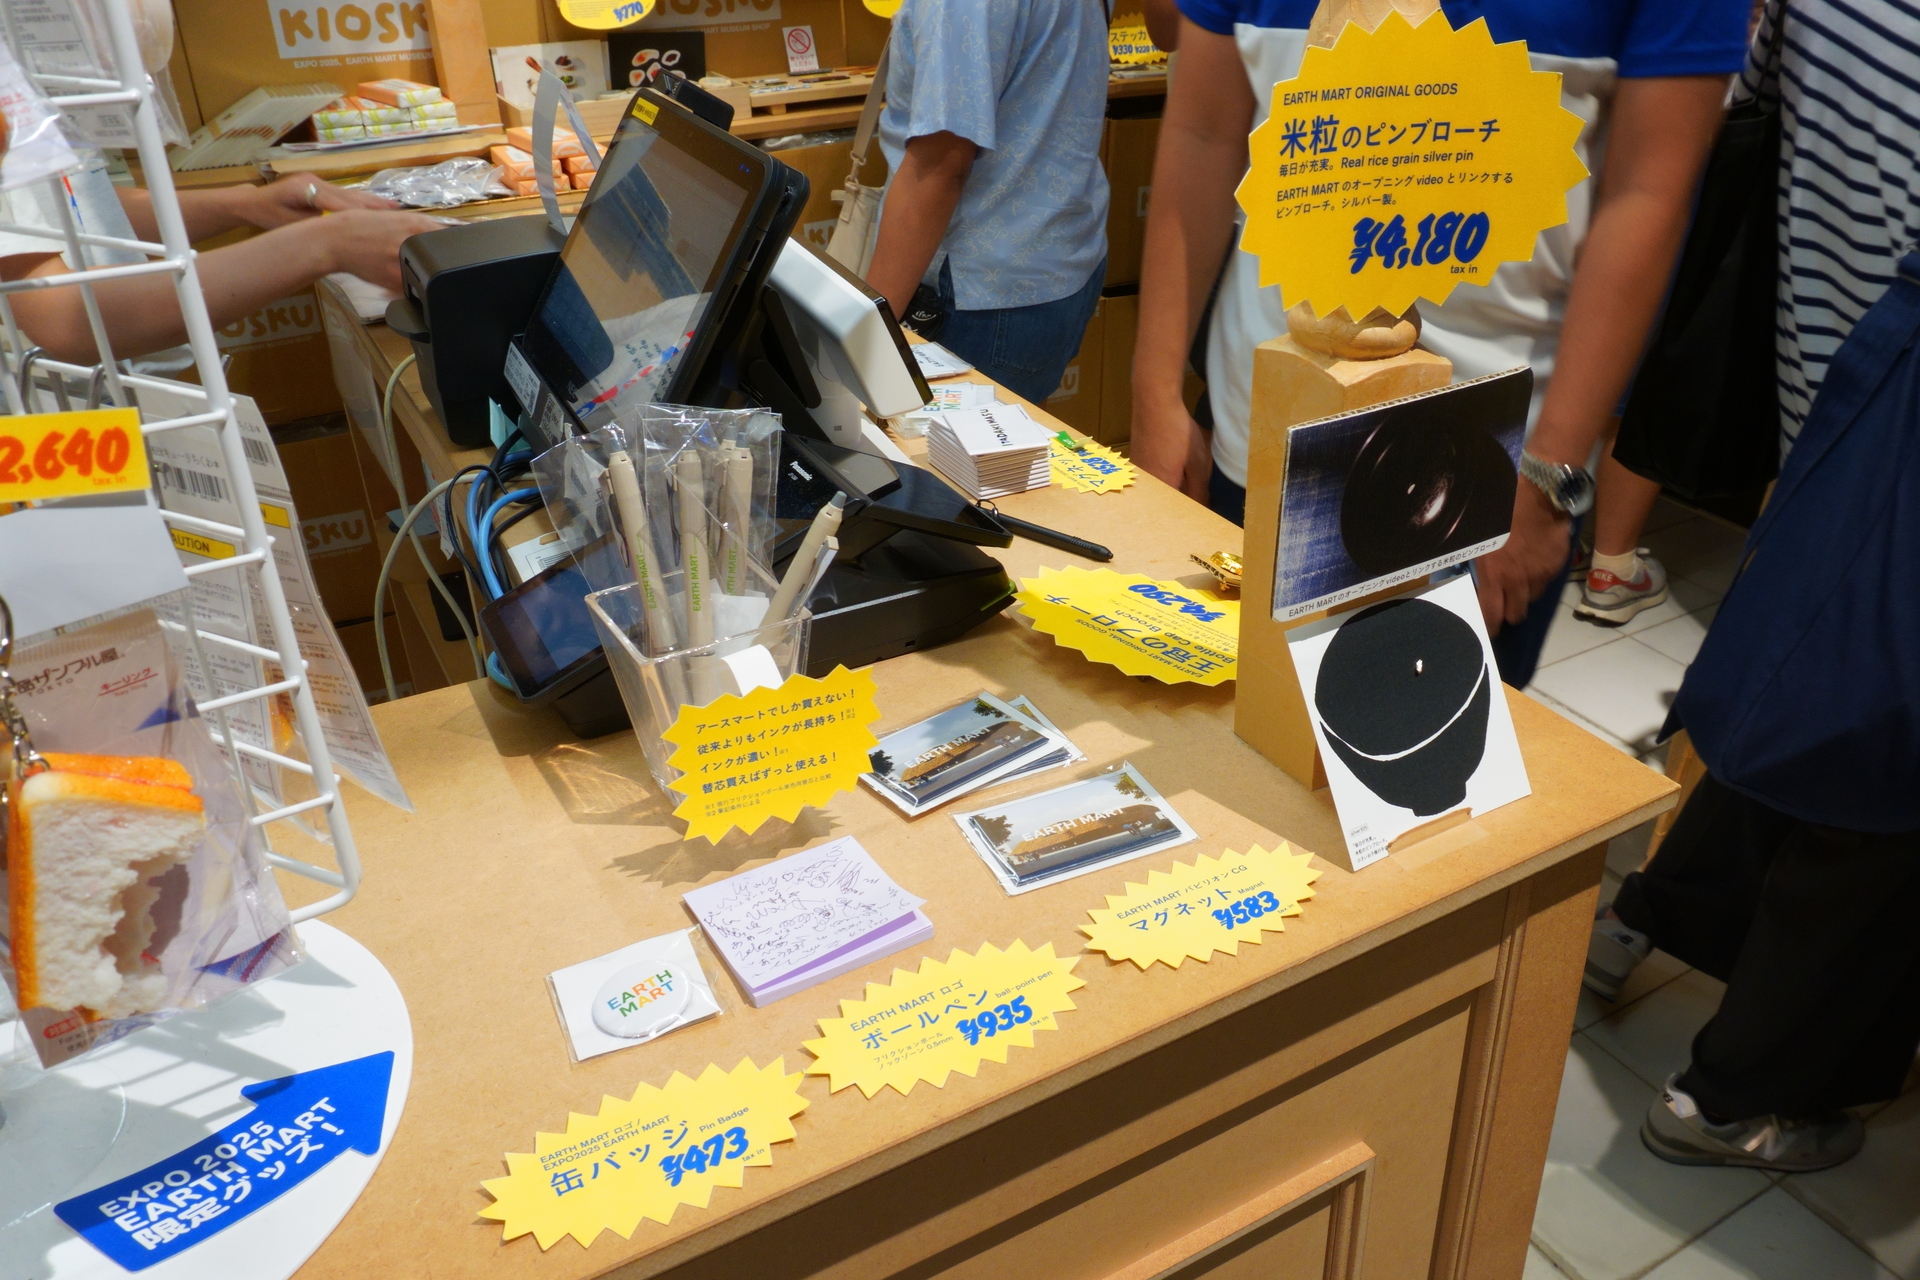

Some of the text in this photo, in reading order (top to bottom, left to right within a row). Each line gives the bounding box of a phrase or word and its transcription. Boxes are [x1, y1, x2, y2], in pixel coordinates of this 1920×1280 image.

[294, 59, 317, 69] EXPO
[346, 56, 373, 65] EARTH
[375, 54, 397, 63] MART
[1283, 83, 1459, 106] EARTH MART ORIGINAL GOODS
[1279, 114, 1501, 159] 米粒のピンブローチ
[1278, 149, 1474, 177] 毎日が充実。 Real rice grain silver pin
[1277, 171, 1514, 202] EARTH MART のオープニング video とリンクする
[1349, 210, 1490, 275] ¥4,180
[1450, 264, 1478, 274] tax in
[943, 389, 962, 410] MART
[0, 426, 131, 485] 2,640
[636, 554, 648, 579] MART
[690, 555, 698, 580] MART
[728, 549, 737, 574] MART
[1593, 571, 1614, 582] NIKE
[642, 580, 657, 610] EARTH
[691, 582, 701, 612] EARTH
[1128, 584, 1226, 622] ¥4,290
[1288, 602, 1315, 618] EARTH
[1044, 594, 1224, 674] 王冠のブローチ
[1075, 618, 1204, 678] EARTH MART ORIGINAL GOODS
[1115, 609, 1236, 664] Bottle Cap Brooch
[696, 688, 856, 735] アースマートでしか買えない！
[904, 726, 991, 769] EARTH MART
[702, 752, 837, 794] 替芯買えばずっと使える！
[1021, 806, 1124, 841] EARTH MART
[1116, 864, 1248, 920] EARTH MART パビリオン CG
[1129, 880, 1265, 931] マグネット Magnet
[1211, 890, 1280, 930] ¥583
[1277, 906, 1288, 914] tax
[606, 969, 673, 1010] EARTH
[618, 980, 675, 1018] MART
[850, 979, 964, 1032] EARTH MART ロゴ
[861, 970, 1054, 1050] ボールペン ball-point pen
[956, 995, 1033, 1046] ¥935
[1029, 1015, 1049, 1027] tax in
[926, 1036, 954, 1050] 0.5mm
[540, 1143, 578, 1164] EARTH
[580, 1132, 610, 1151] MART
[543, 1115, 672, 1171] EXPO2025 EARTH MART
[550, 1106, 750, 1197] 缶バッジ Pin Badge
[658, 1126, 750, 1187] ¥473
[741, 1147, 765, 1162] tax in
[98, 1120, 275, 1218] EXPO 2025
[114, 1096, 337, 1233] EARTH MART
